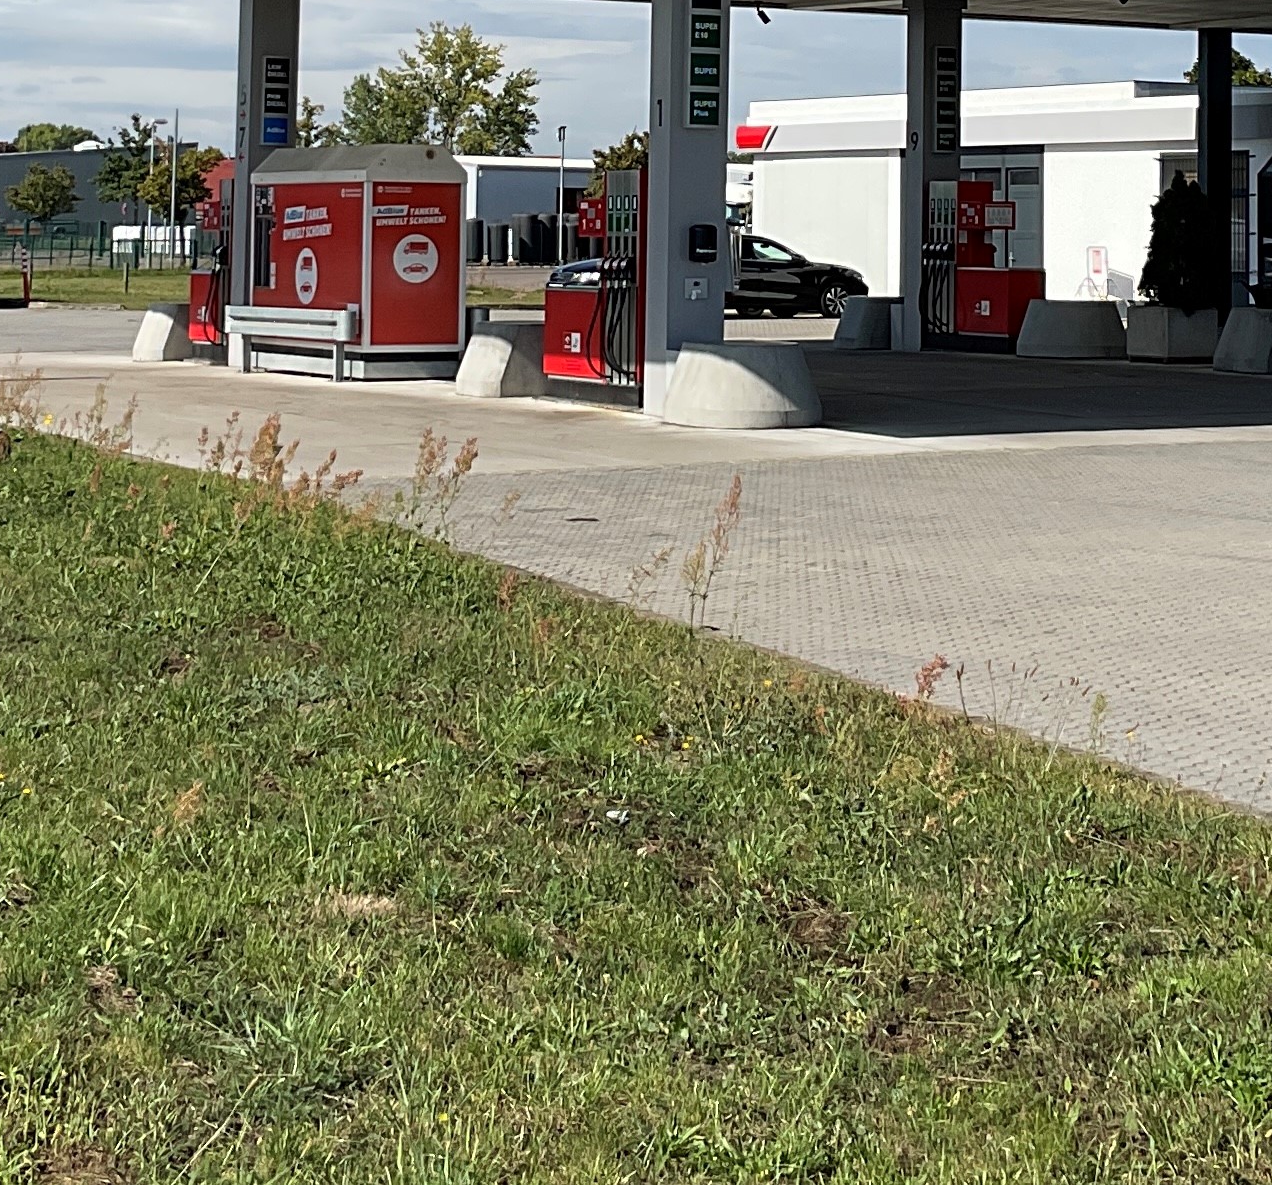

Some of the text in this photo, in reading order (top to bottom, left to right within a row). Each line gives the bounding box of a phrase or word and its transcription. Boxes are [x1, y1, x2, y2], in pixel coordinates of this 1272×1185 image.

[694, 22, 719, 30] SUPER
[694, 67, 718, 75] SUPER
[239, 83, 247, 107] 5
[693, 100, 717, 108] SUPER
[657, 98, 663, 127] 1
[239, 126, 246, 149] 7
[910, 131, 919, 152] 9
[375, 217, 408, 227] UMWELT
[582, 218, 587, 231] 1
